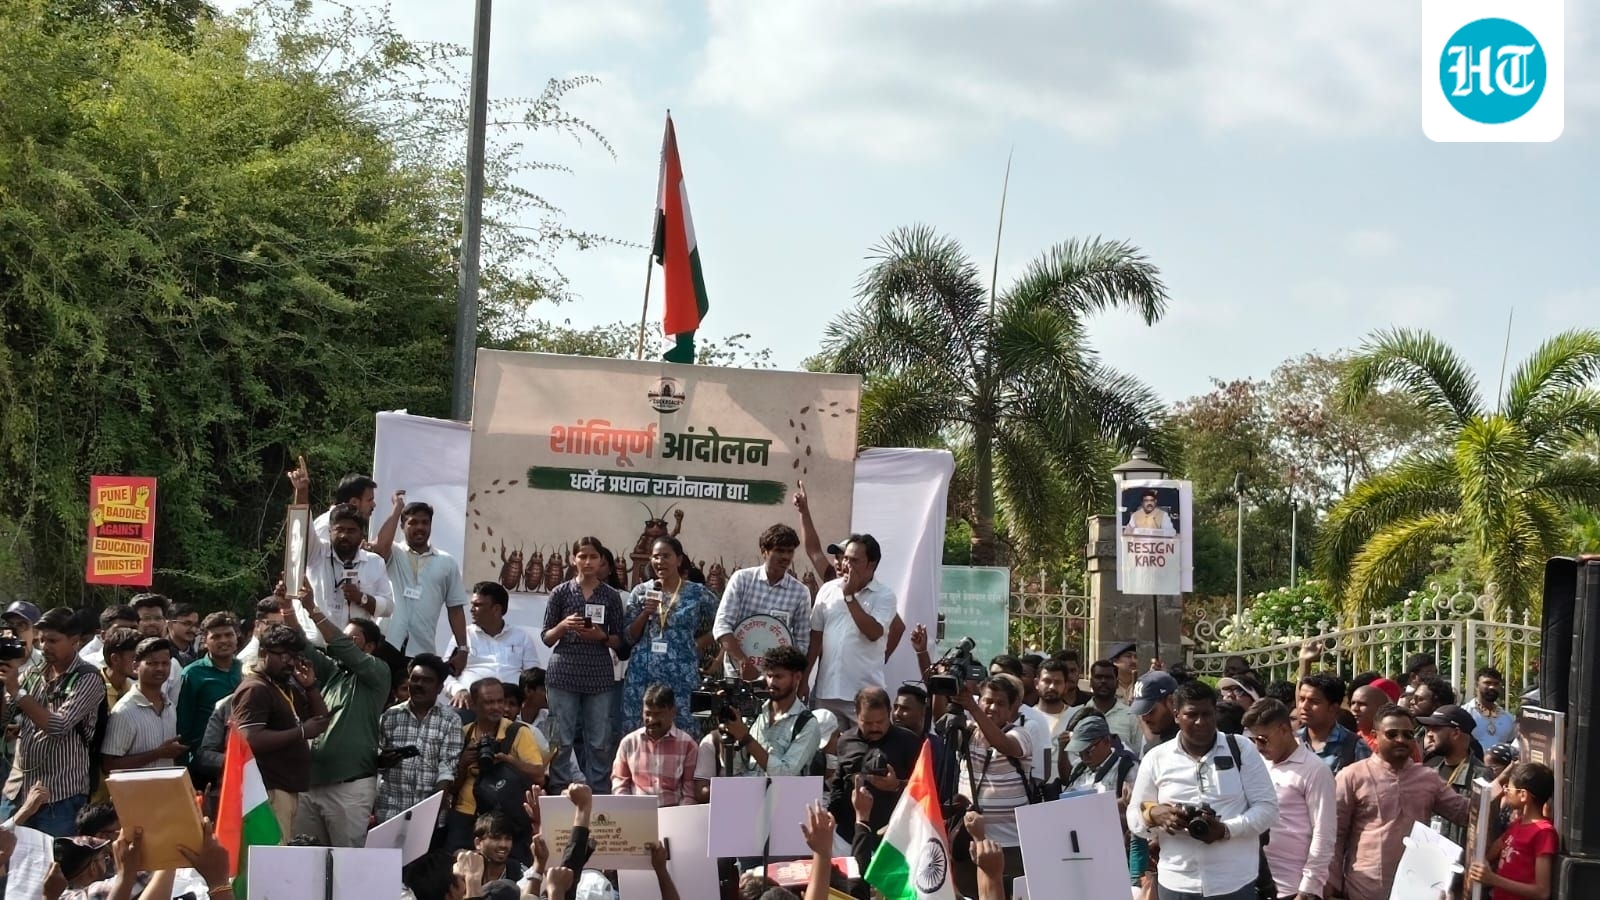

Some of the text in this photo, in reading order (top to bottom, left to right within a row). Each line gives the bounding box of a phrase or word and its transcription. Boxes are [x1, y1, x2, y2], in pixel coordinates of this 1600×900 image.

[550, 419, 773, 468] शांतिपूर्ण आंदोलन
[608, 476, 650, 495] प्रधान
[652, 475, 723, 500] राजीनामा
[100, 488, 128, 502] PUNE
[106, 506, 147, 520] BADDIES
[99, 524, 139, 536] AGAINST
[95, 541, 148, 555] EDUCATION
[1127, 542, 1175, 554] RESIGN
[97, 559, 142, 571] MINISTER
[1135, 555, 1166, 567] KARO
